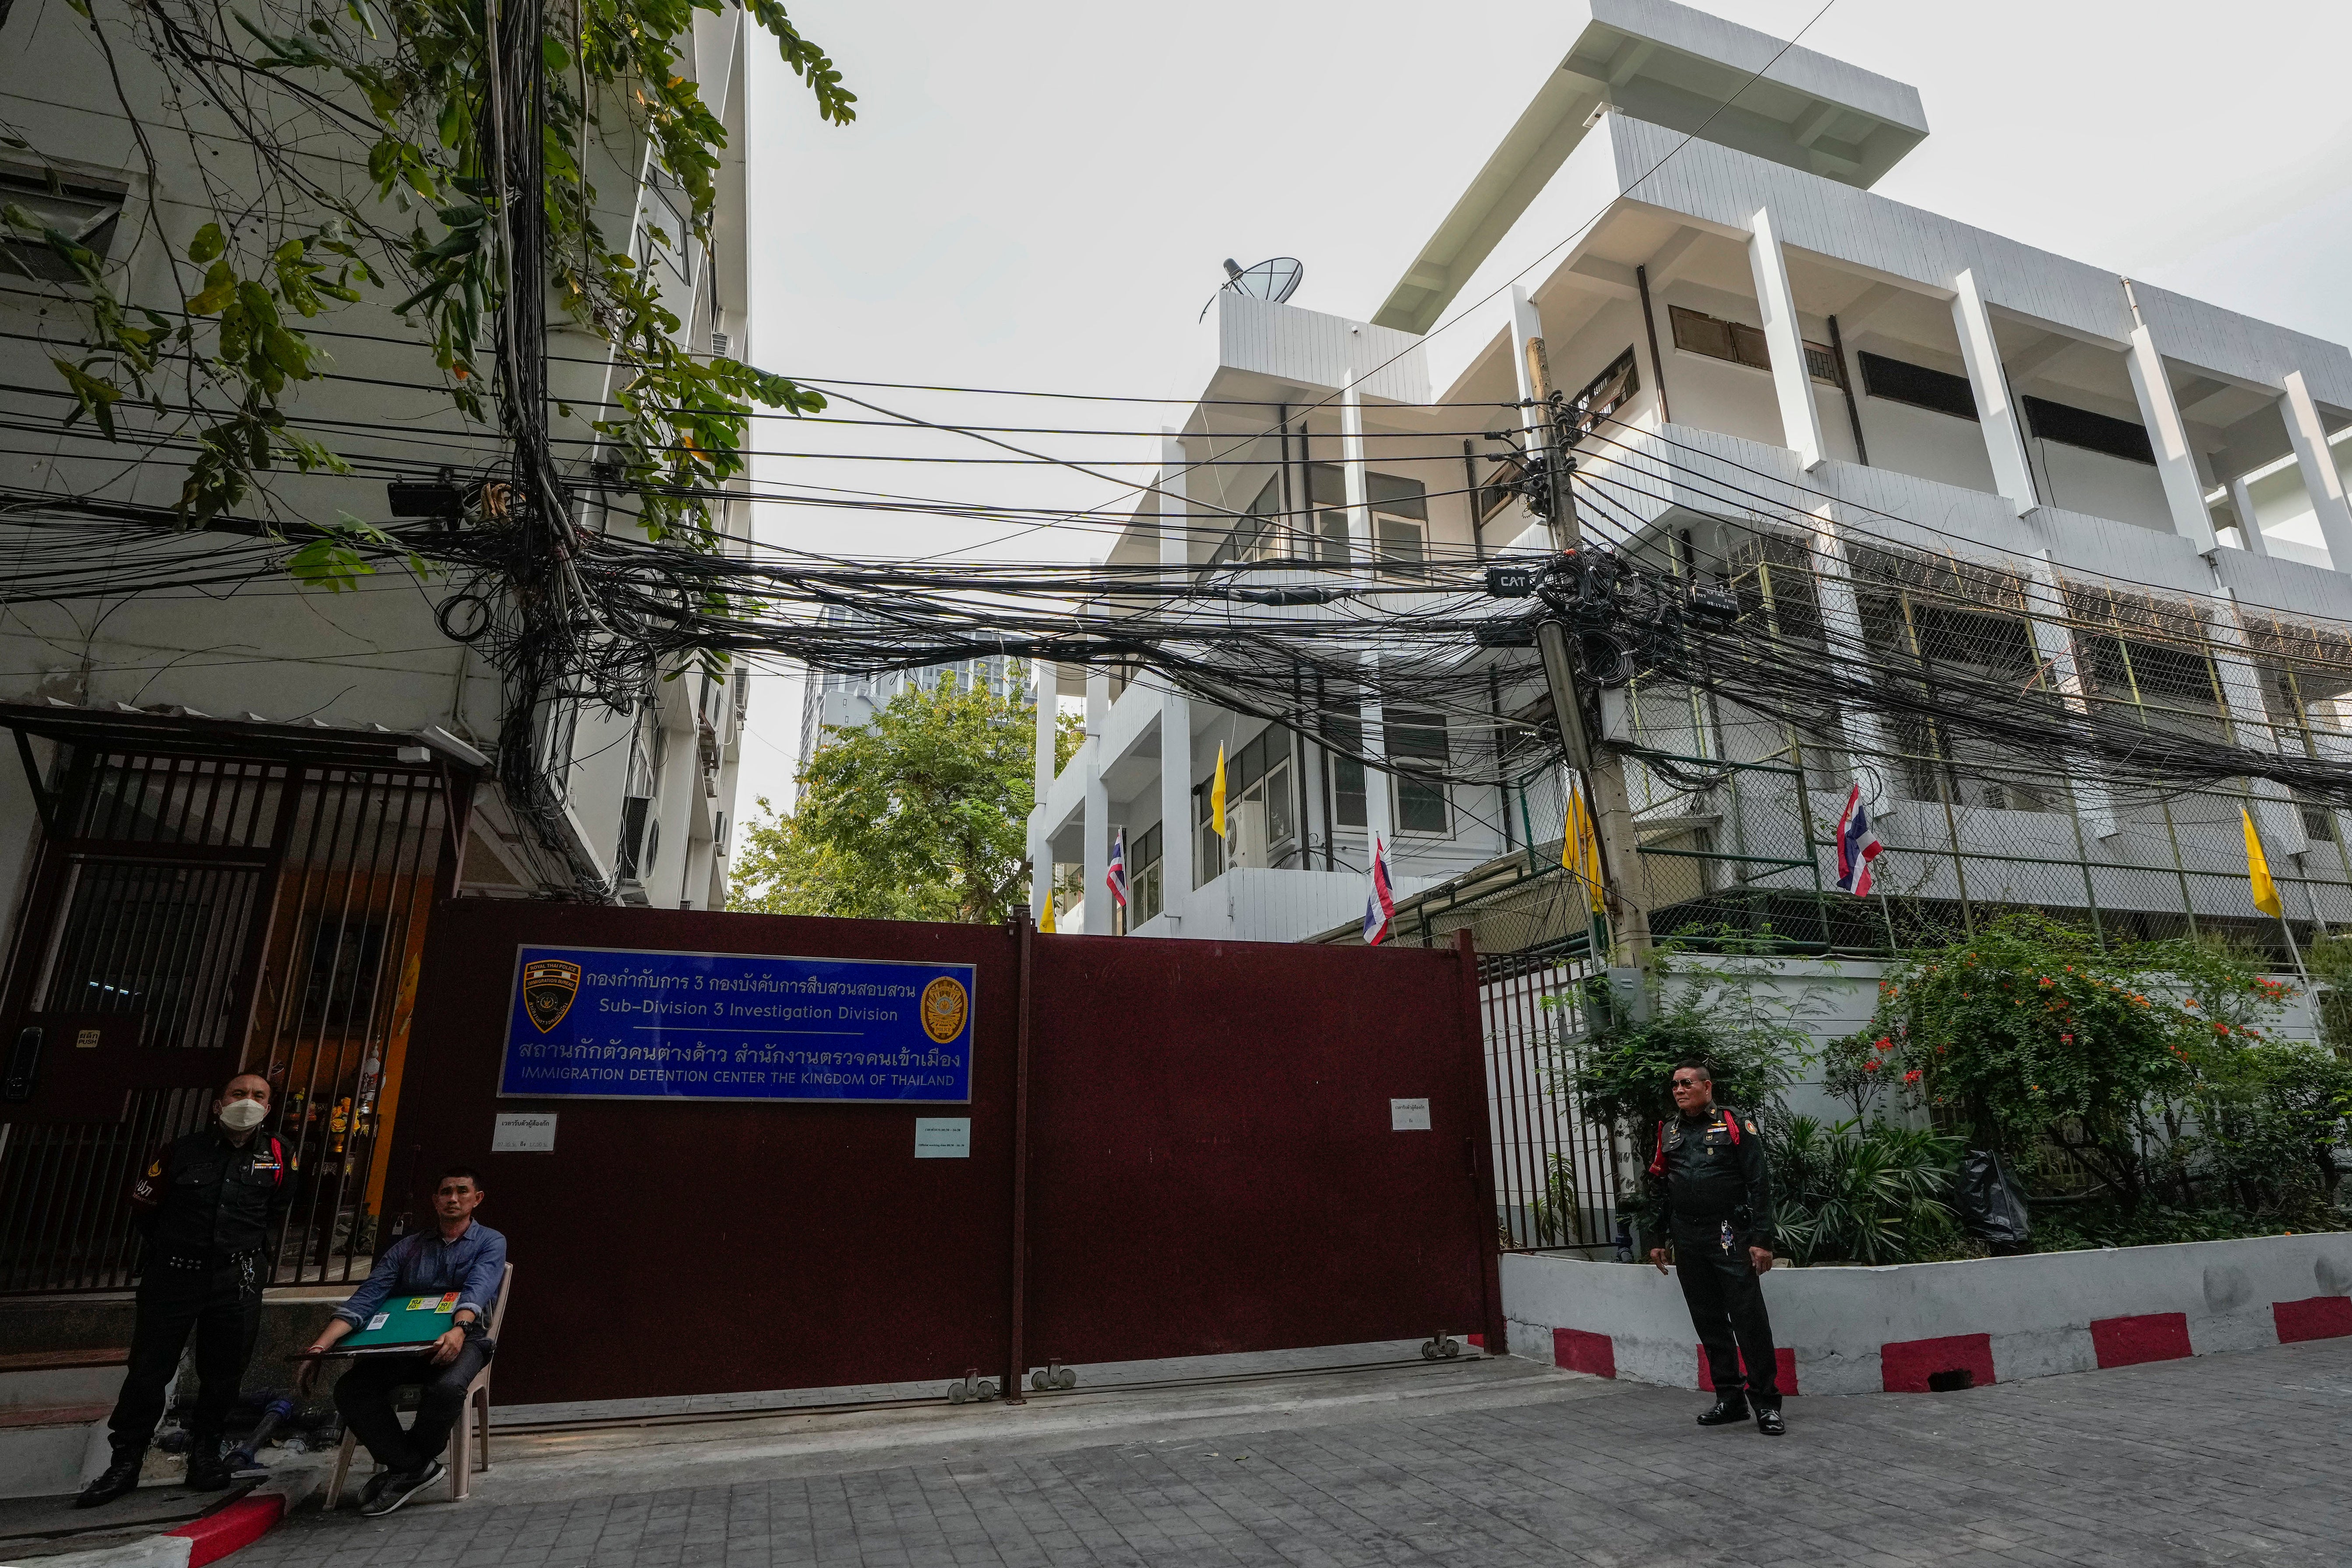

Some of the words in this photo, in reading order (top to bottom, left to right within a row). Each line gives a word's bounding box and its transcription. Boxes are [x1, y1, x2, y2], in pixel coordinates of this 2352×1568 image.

[1501, 576, 1526, 587] CAT
[586, 968, 689, 990] กองกำกับการ
[694, 975, 704, 990] 3
[709, 973, 916, 998] กองบังคับการสืบสวนสอบสวน
[599, 998, 707, 1015] Sub-Division
[713, 1002, 724, 1016] 3
[730, 1003, 832, 1021] Investigation
[838, 1006, 898, 1021] Division
[519, 1038, 727, 1063] สถานกักตัวคนต่างด้าว
[734, 1042, 960, 1067] สำนักงานตรวจคนเข้าเมือง
[521, 1067, 624, 1080] IMMIGRATION
[629, 1069, 708, 1082] DETENTION
[713, 1071, 766, 1083] CENTER
[770, 1072, 796, 1084] THE
[801, 1072, 865, 1085] KINGDOM
[869, 1074, 886, 1085] OF
[890, 1074, 954, 1086] THAILAND
[502, 1119, 549, 1128] เวลารับตัวผู้ต้องกัก
